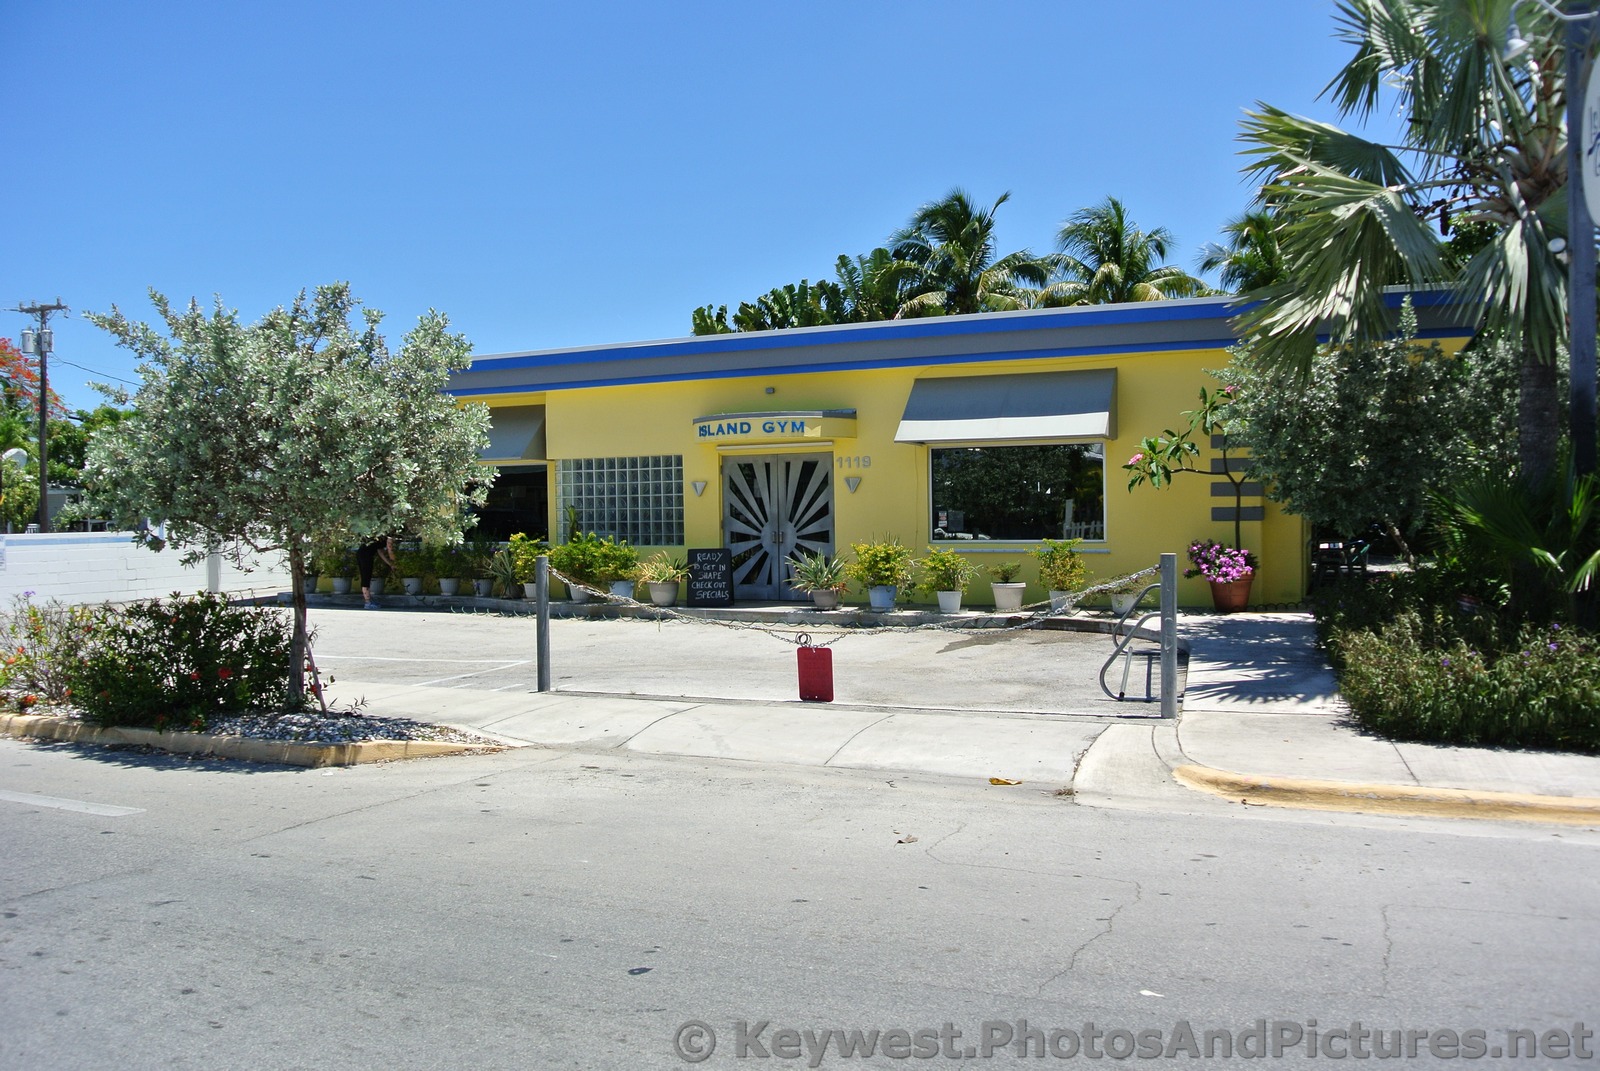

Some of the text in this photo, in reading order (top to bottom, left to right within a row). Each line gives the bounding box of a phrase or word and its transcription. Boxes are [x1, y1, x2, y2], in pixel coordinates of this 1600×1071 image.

[699, 421, 805, 437] ISLAND GYM
[836, 456, 871, 468] 1119
[696, 552, 722, 562] READY
[698, 571, 722, 579] SHAPE
[691, 581, 726, 589] CHECK OUT
[695, 590, 730, 600] SPECIALS
